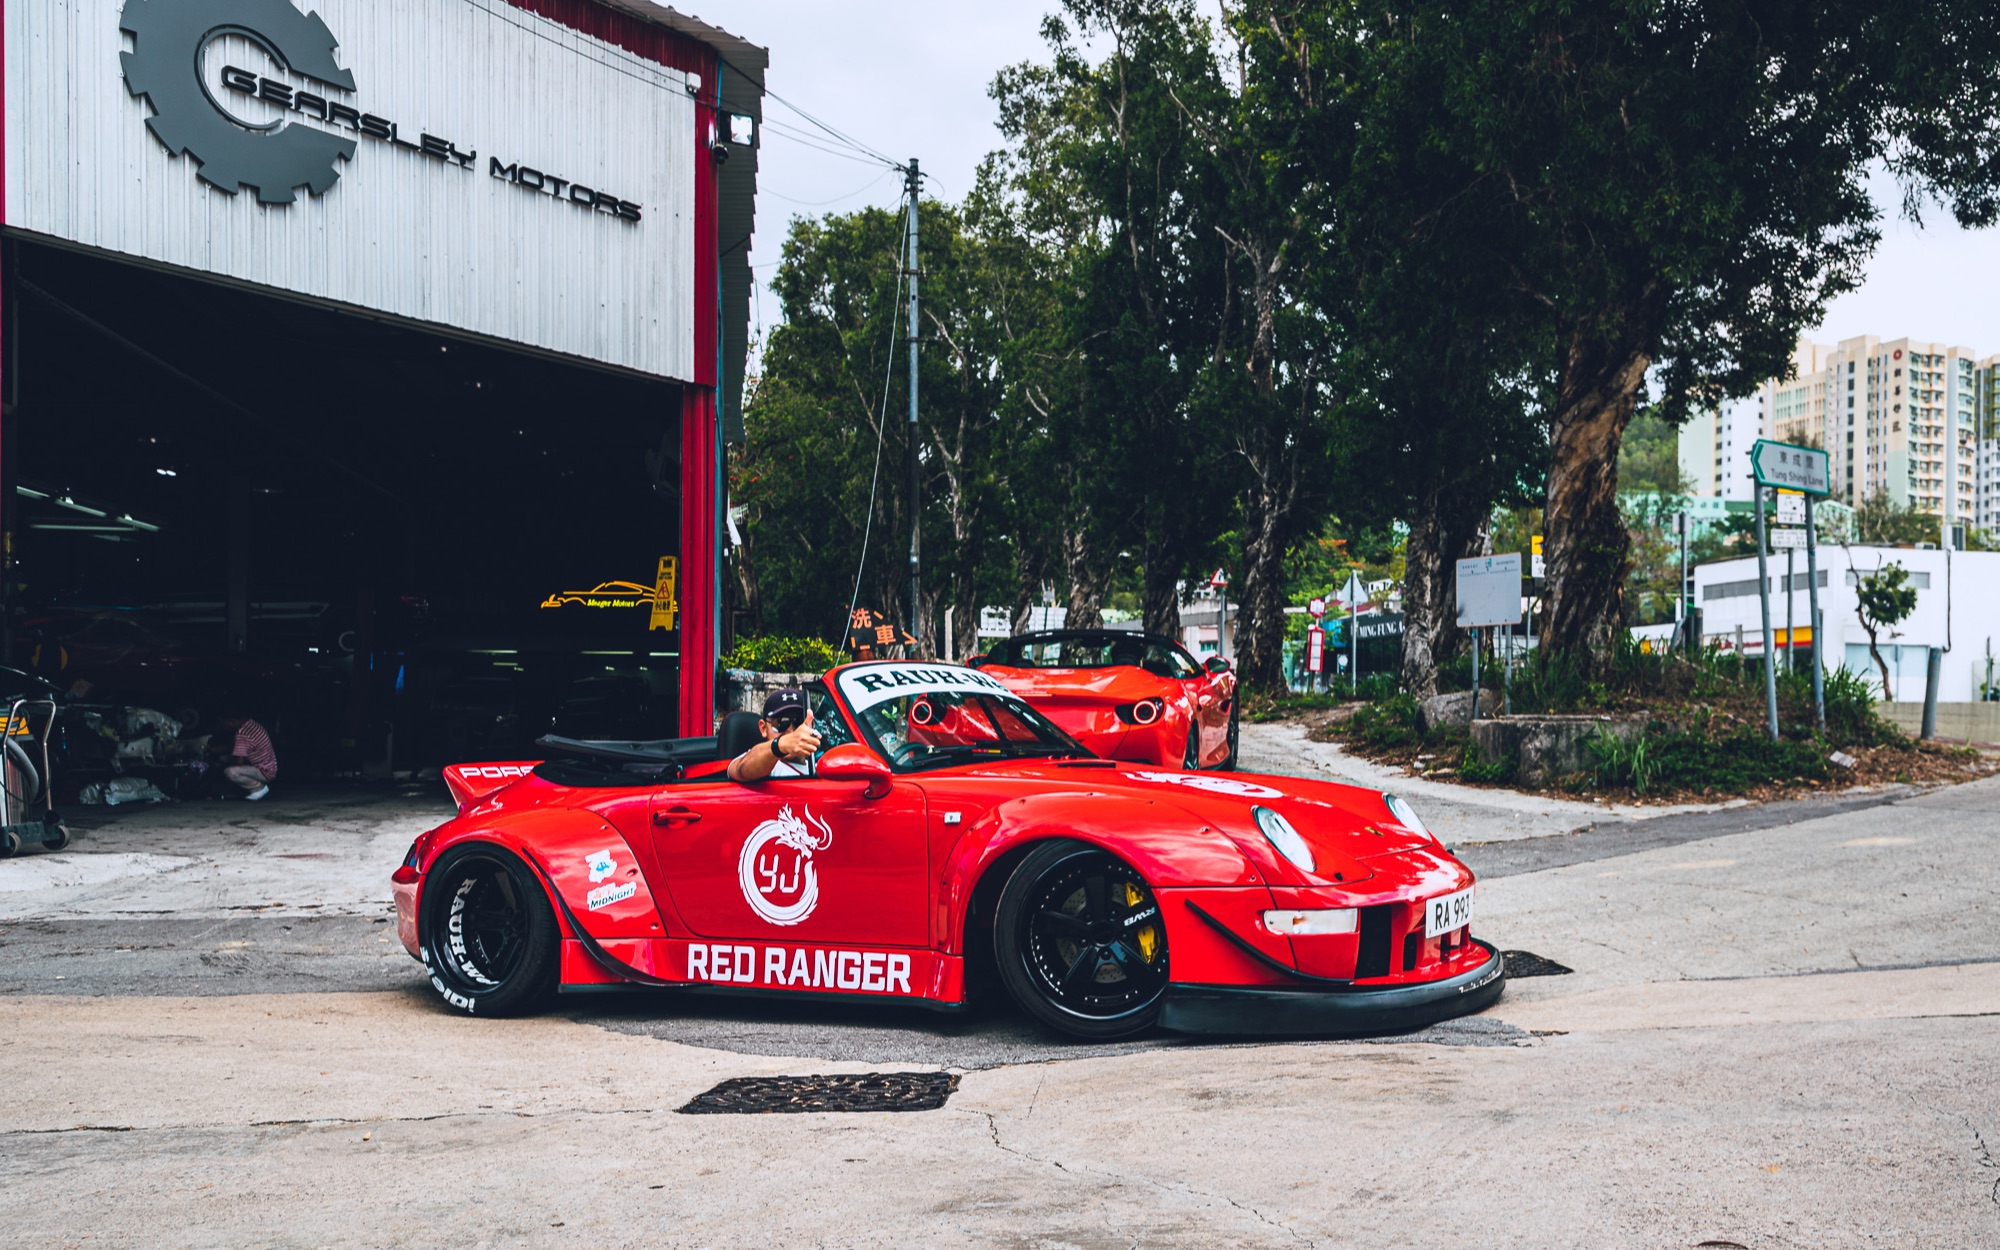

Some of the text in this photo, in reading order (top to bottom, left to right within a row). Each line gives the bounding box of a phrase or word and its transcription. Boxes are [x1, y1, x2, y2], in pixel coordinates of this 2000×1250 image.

[221, 65, 642, 222] GEARSLEY MOTORS
[1770, 468, 1824, 486] Tung Shing Lane
[851, 607, 897, 646] 洗車
[1359, 624, 1377, 638] MING
[1377, 620, 1397, 636] FUNG
[590, 887, 634, 909] MIDNIGHT
[1435, 893, 1470, 931] RA 993
[687, 943, 911, 994] RED RANGER
